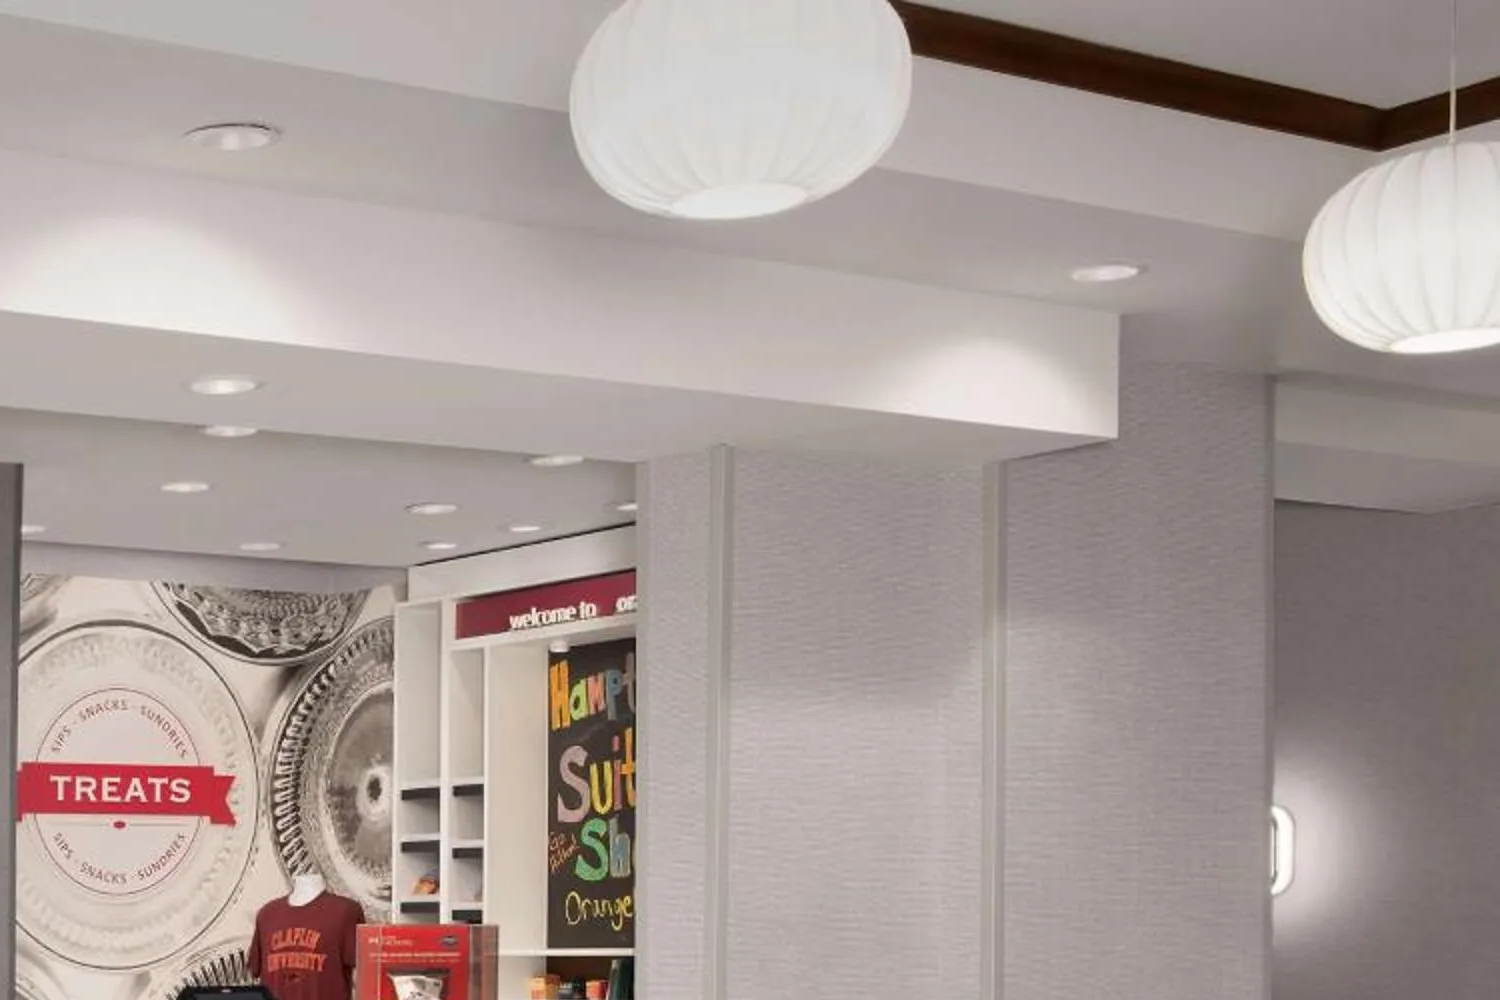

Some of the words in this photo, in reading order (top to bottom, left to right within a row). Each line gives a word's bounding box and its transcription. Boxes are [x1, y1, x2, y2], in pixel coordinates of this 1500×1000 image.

[509, 606, 577, 629] welcome
[580, 600, 598, 620] to
[51, 724, 72, 753] SIPS
[79, 699, 129, 722] SNACKS
[140, 705, 190, 759] SUNDRIES
[49, 773, 192, 804] TREATS
[53, 831, 75, 860] SIPS
[79, 861, 128, 885] SNACKS
[137, 832, 186, 881] SUNDRIES
[574, 817, 636, 881] Sh
